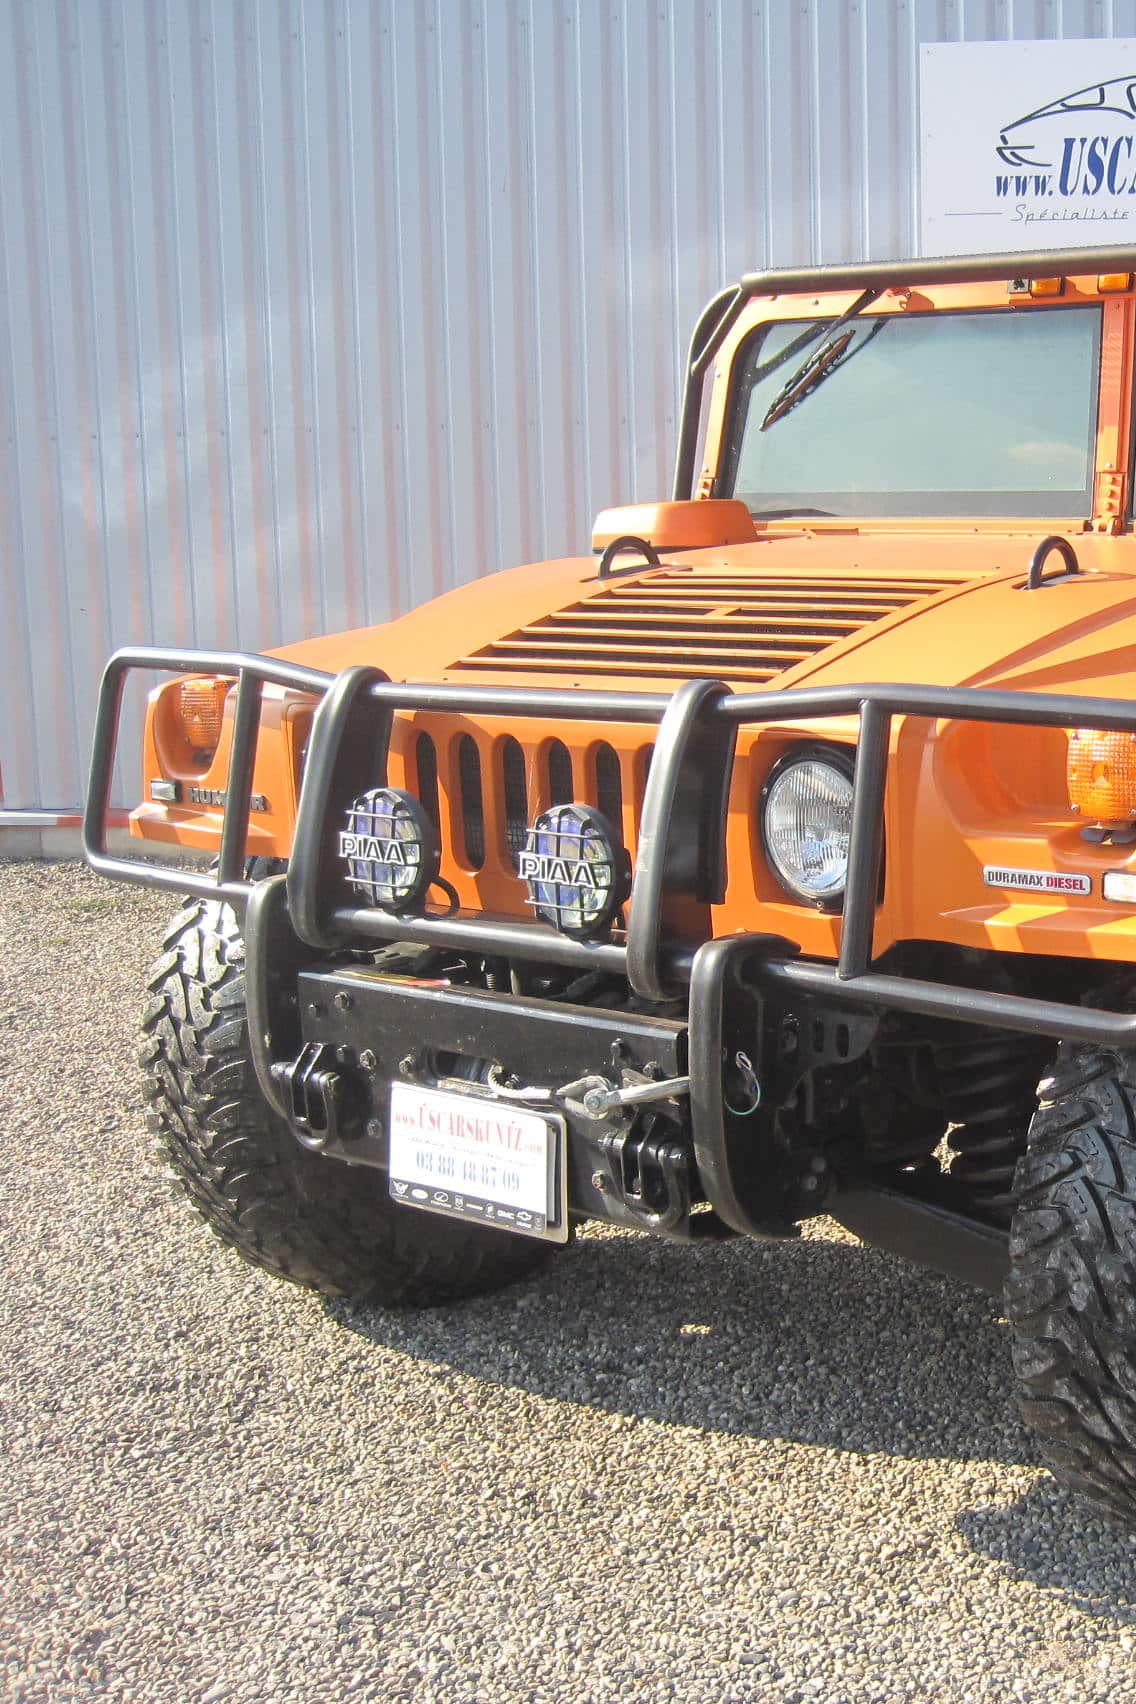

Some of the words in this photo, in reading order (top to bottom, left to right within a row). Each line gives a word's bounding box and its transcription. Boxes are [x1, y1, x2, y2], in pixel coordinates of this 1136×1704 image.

[1011, 203, 1129, 224] Spécialiste
[188, 786, 267, 811] HUMR
[339, 832, 405, 865] PIAA
[519, 852, 597, 888] PIAA
[988, 871, 1043, 887] DURAMAX
[1046, 876, 1086, 890] DIESEL
